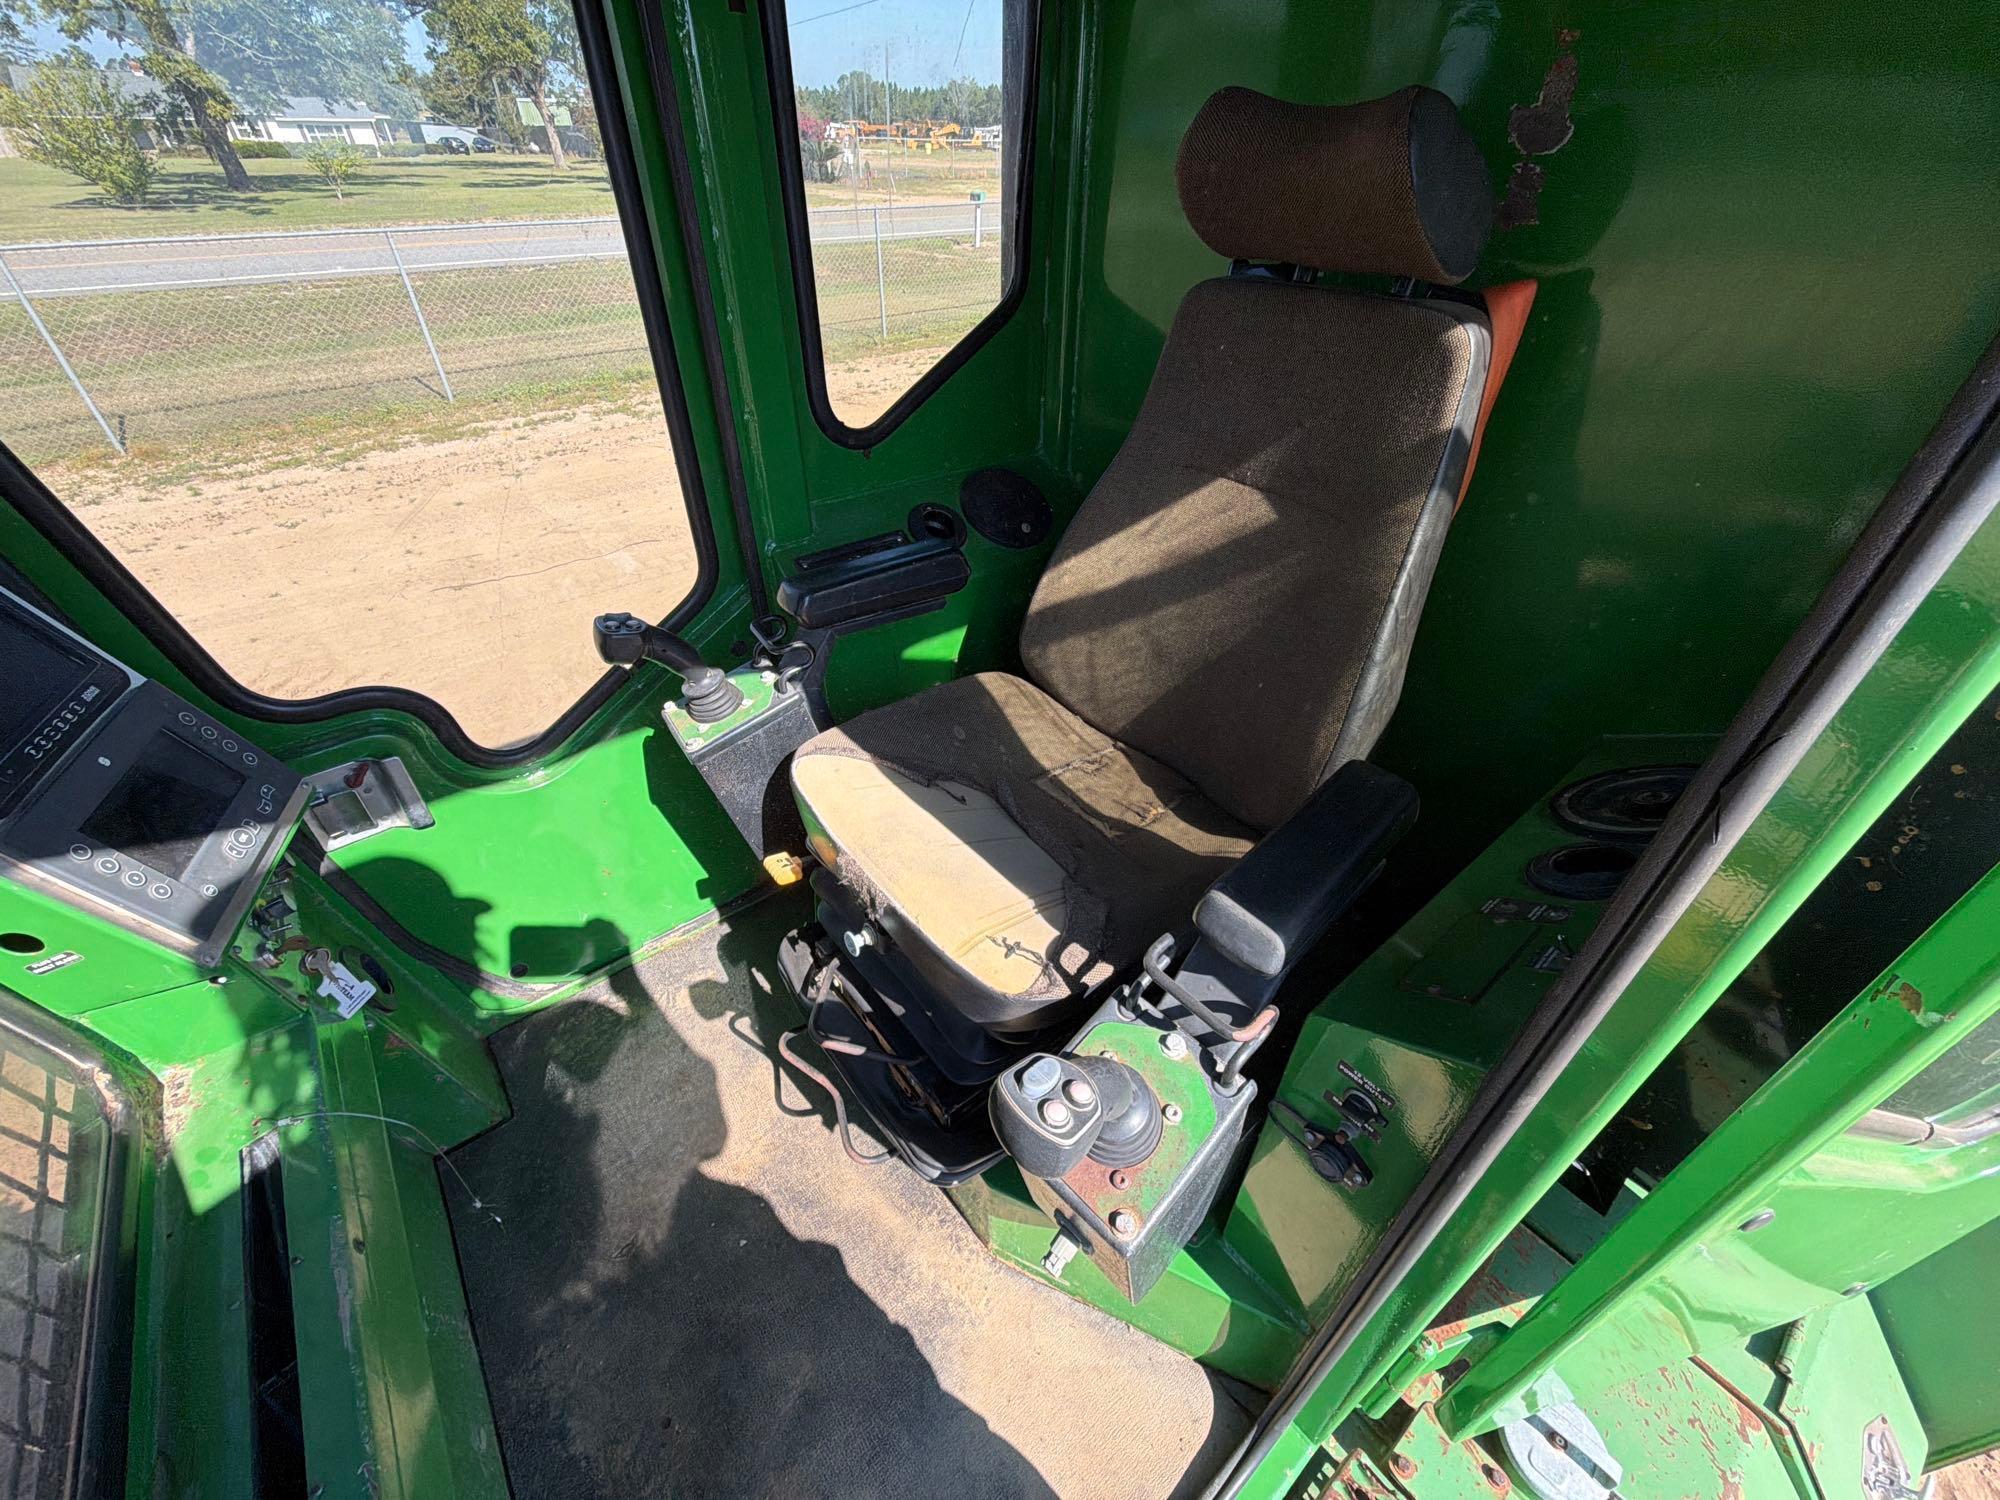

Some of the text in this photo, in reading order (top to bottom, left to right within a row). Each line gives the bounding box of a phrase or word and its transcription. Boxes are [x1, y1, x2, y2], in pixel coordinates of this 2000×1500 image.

[1339, 1064, 1363, 1085] POWER
[1364, 1083, 1392, 1108] OUTLET
[1363, 1076, 1381, 1092] VOLT
